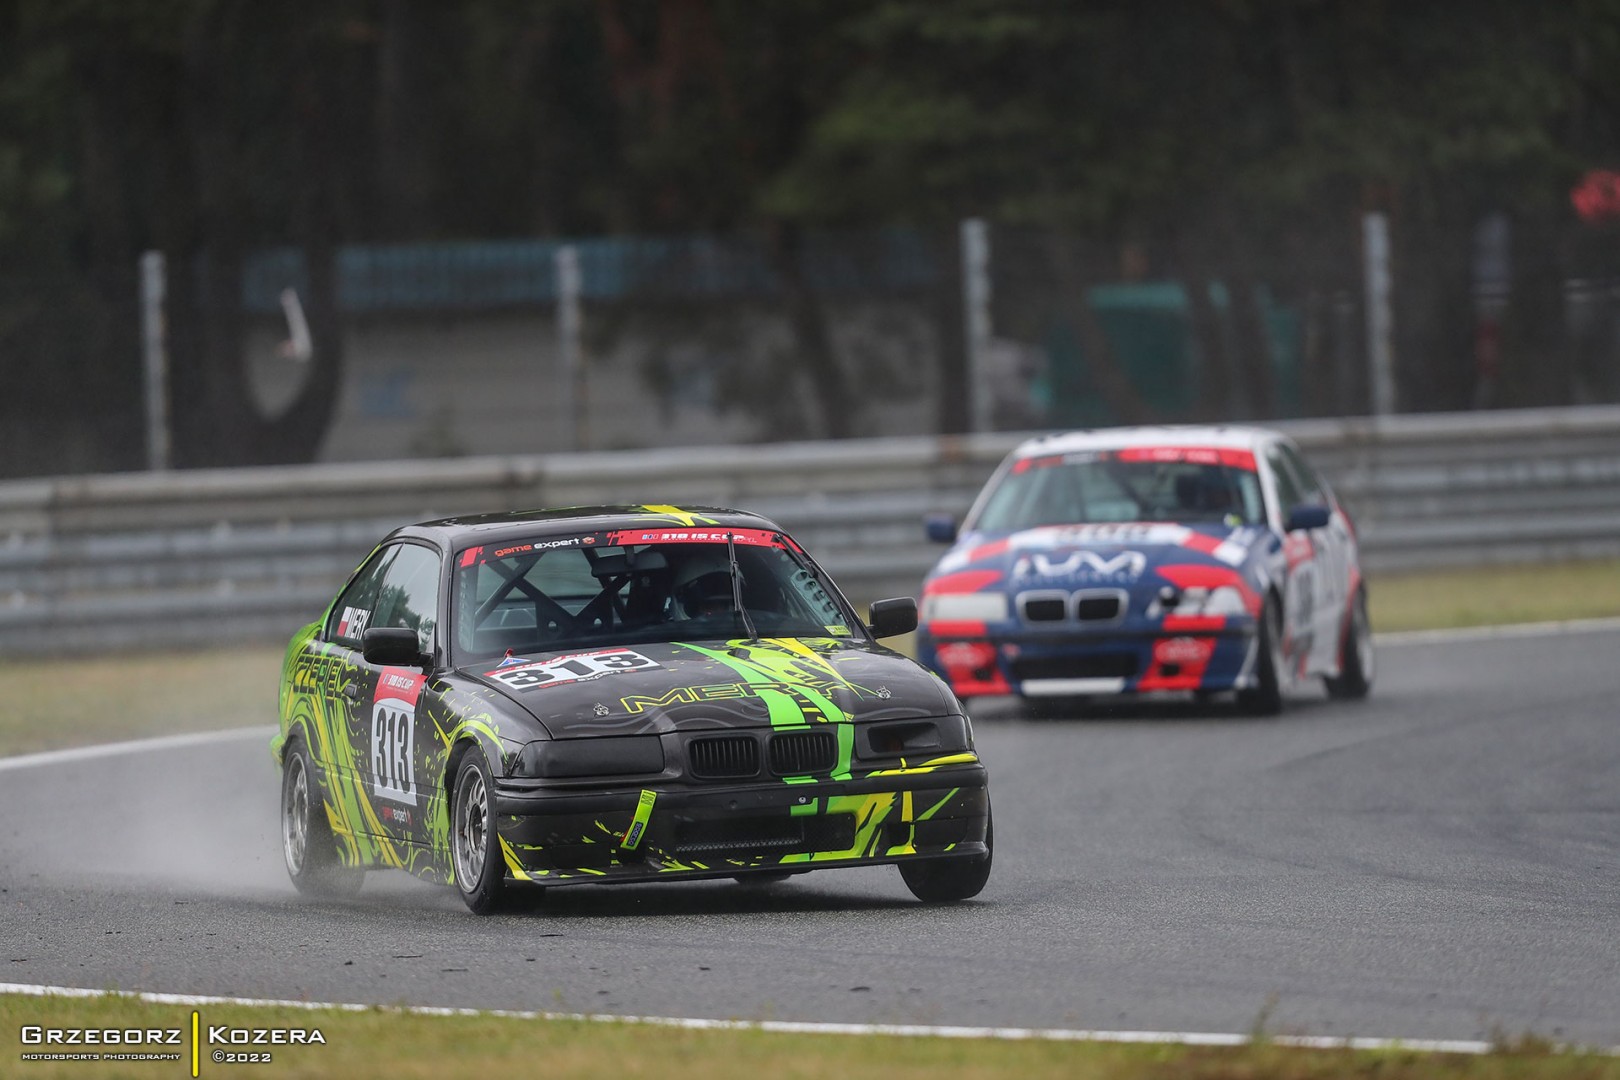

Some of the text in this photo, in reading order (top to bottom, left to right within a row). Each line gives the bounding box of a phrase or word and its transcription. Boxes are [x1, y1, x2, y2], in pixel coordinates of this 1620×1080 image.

[494, 537, 580, 557] game expert
[500, 653, 649, 686] 313
[374, 707, 410, 794] 313
